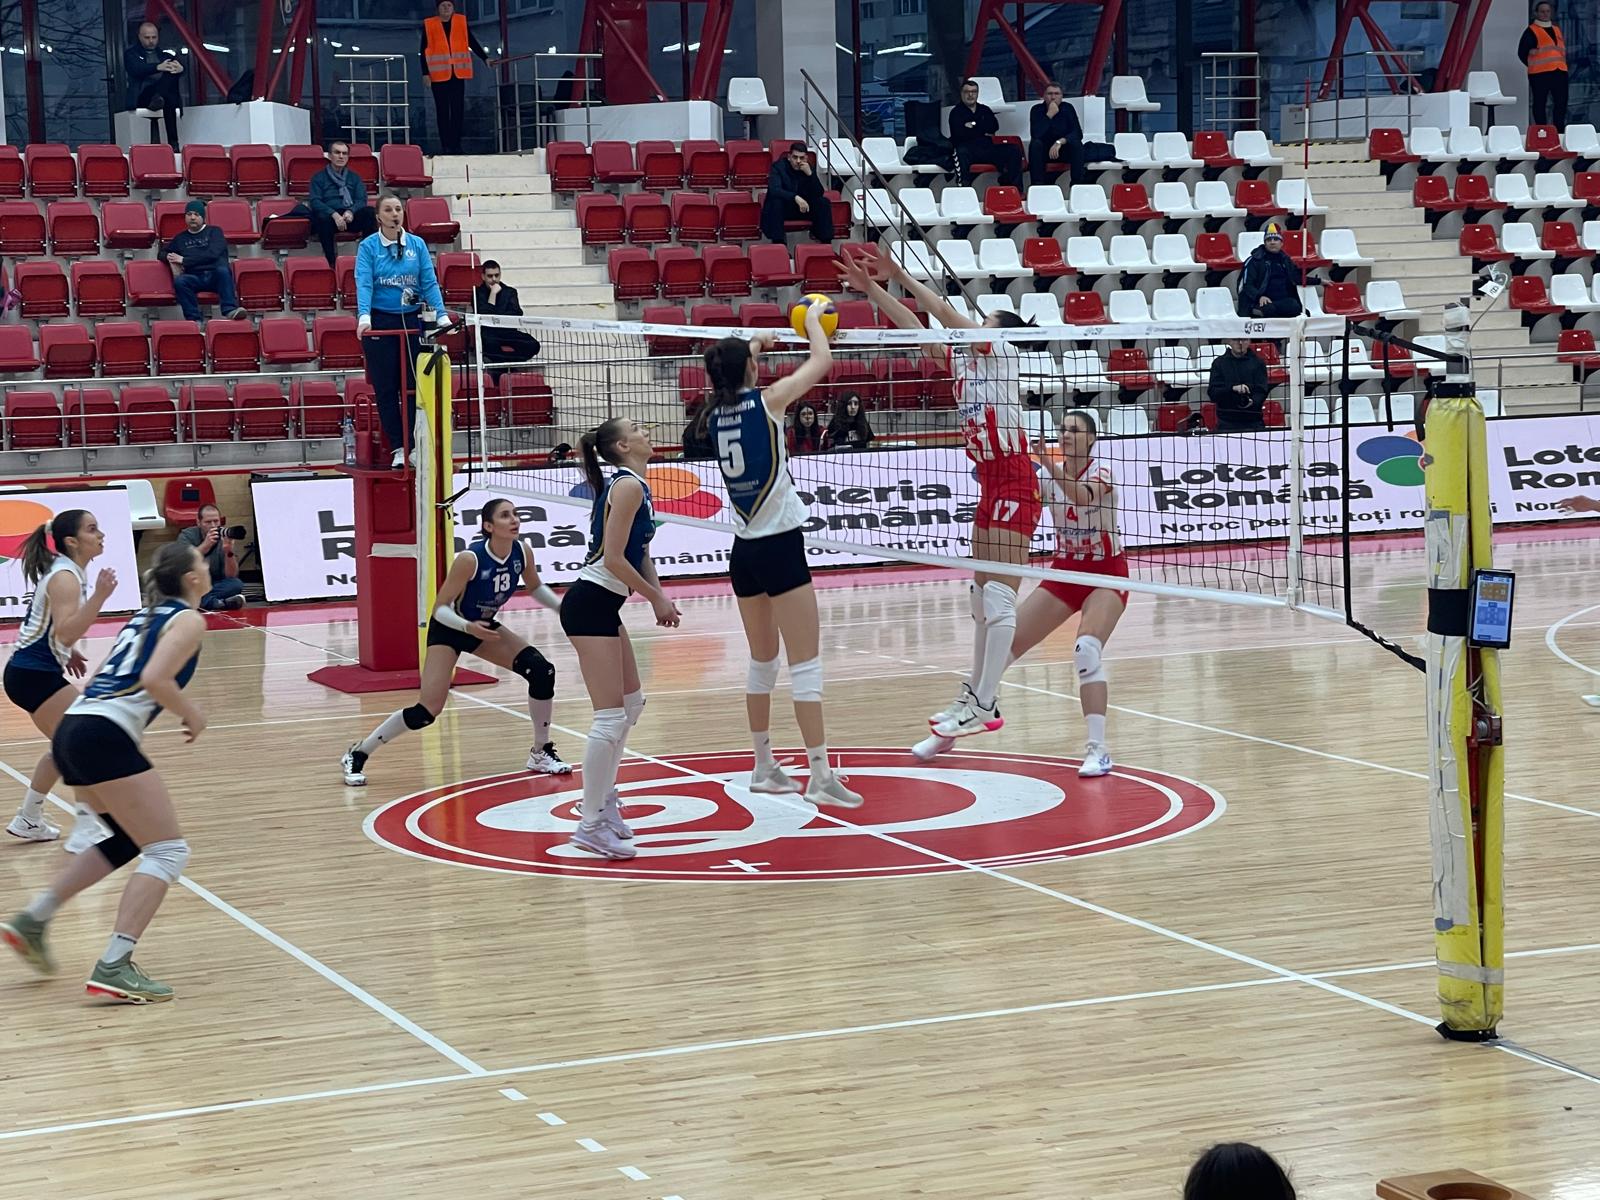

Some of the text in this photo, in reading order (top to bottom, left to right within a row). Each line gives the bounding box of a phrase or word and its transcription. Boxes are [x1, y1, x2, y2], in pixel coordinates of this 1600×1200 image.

[717, 428, 746, 479] 5
[1148, 462, 1340, 488] Lotera
[992, 499, 1020, 522] 17
[1160, 521, 1241, 534] Noroc
[492, 573, 511, 593] 13
